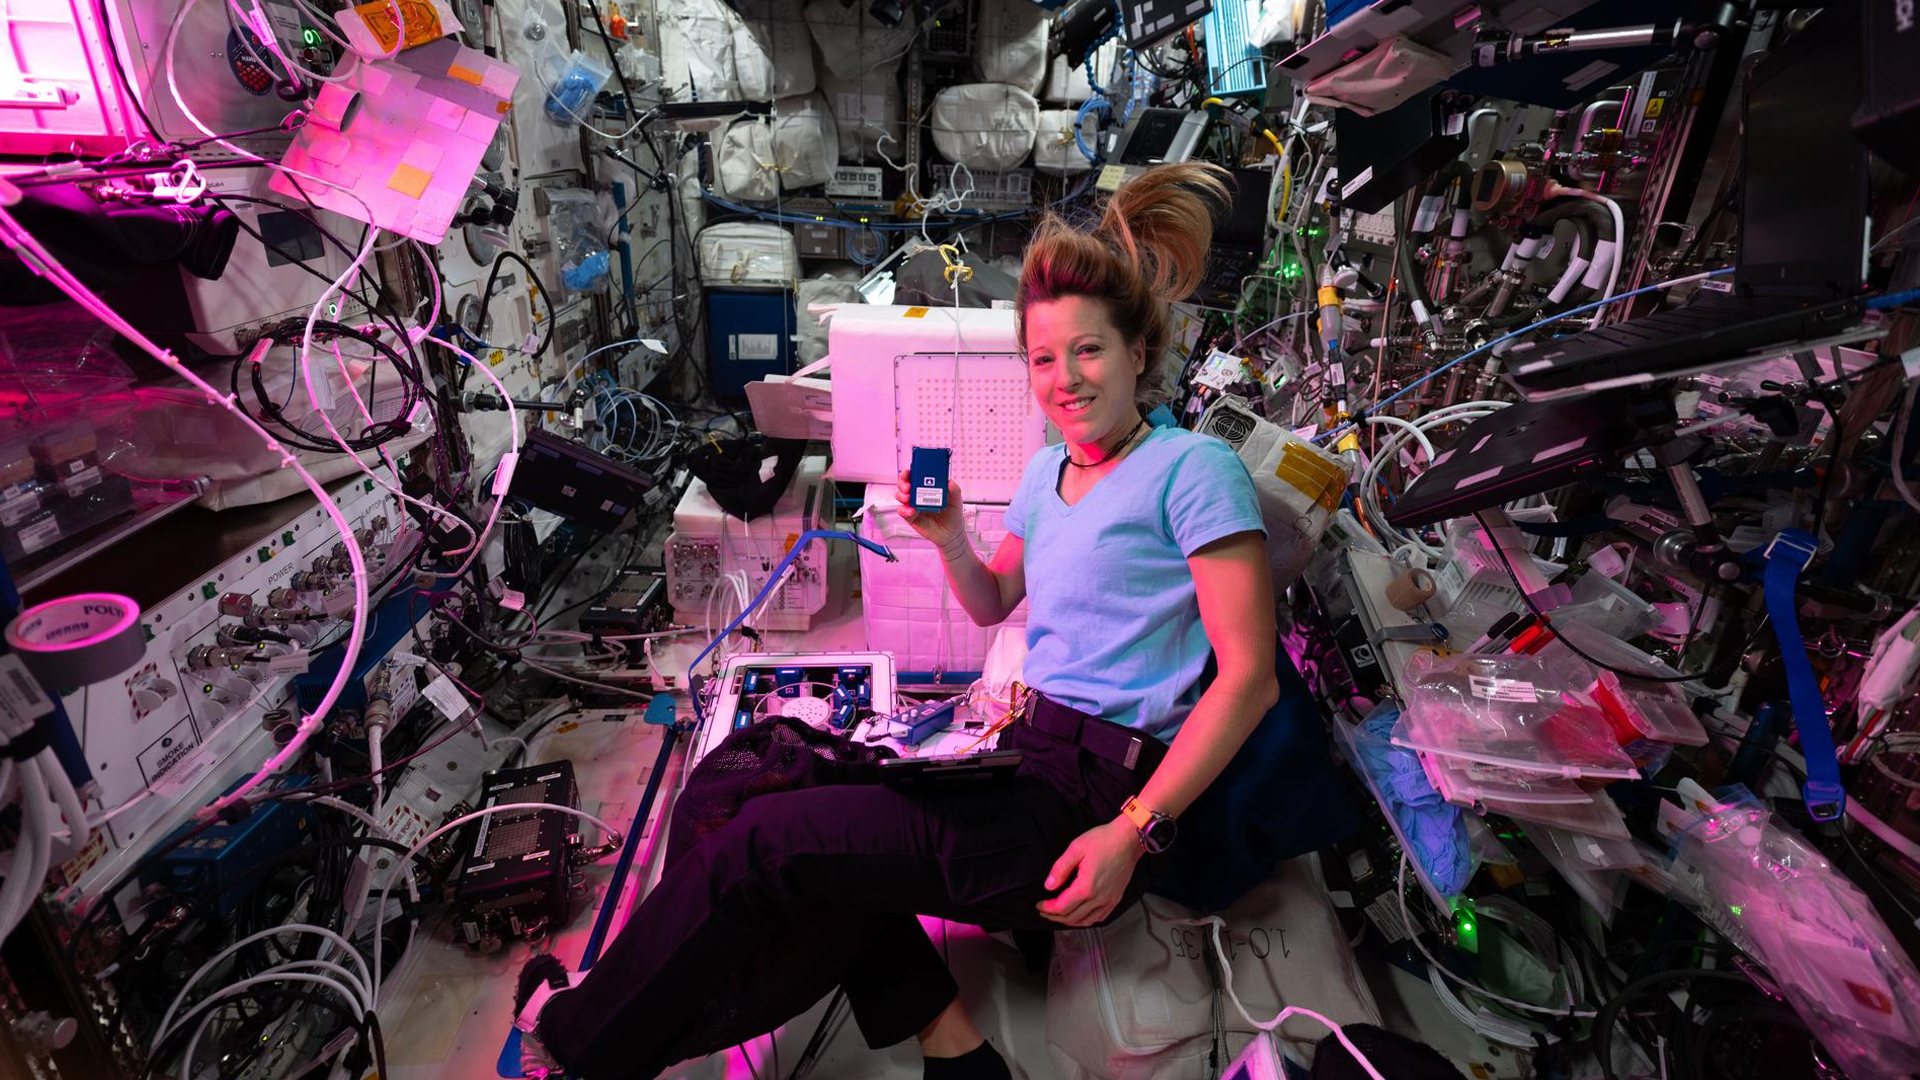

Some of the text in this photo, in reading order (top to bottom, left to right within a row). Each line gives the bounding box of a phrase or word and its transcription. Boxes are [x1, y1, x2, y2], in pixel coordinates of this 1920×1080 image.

[268, 562, 294, 586] POWER
[152, 743, 195, 783] INDICATION
[157, 743, 185, 769] SMOKE
